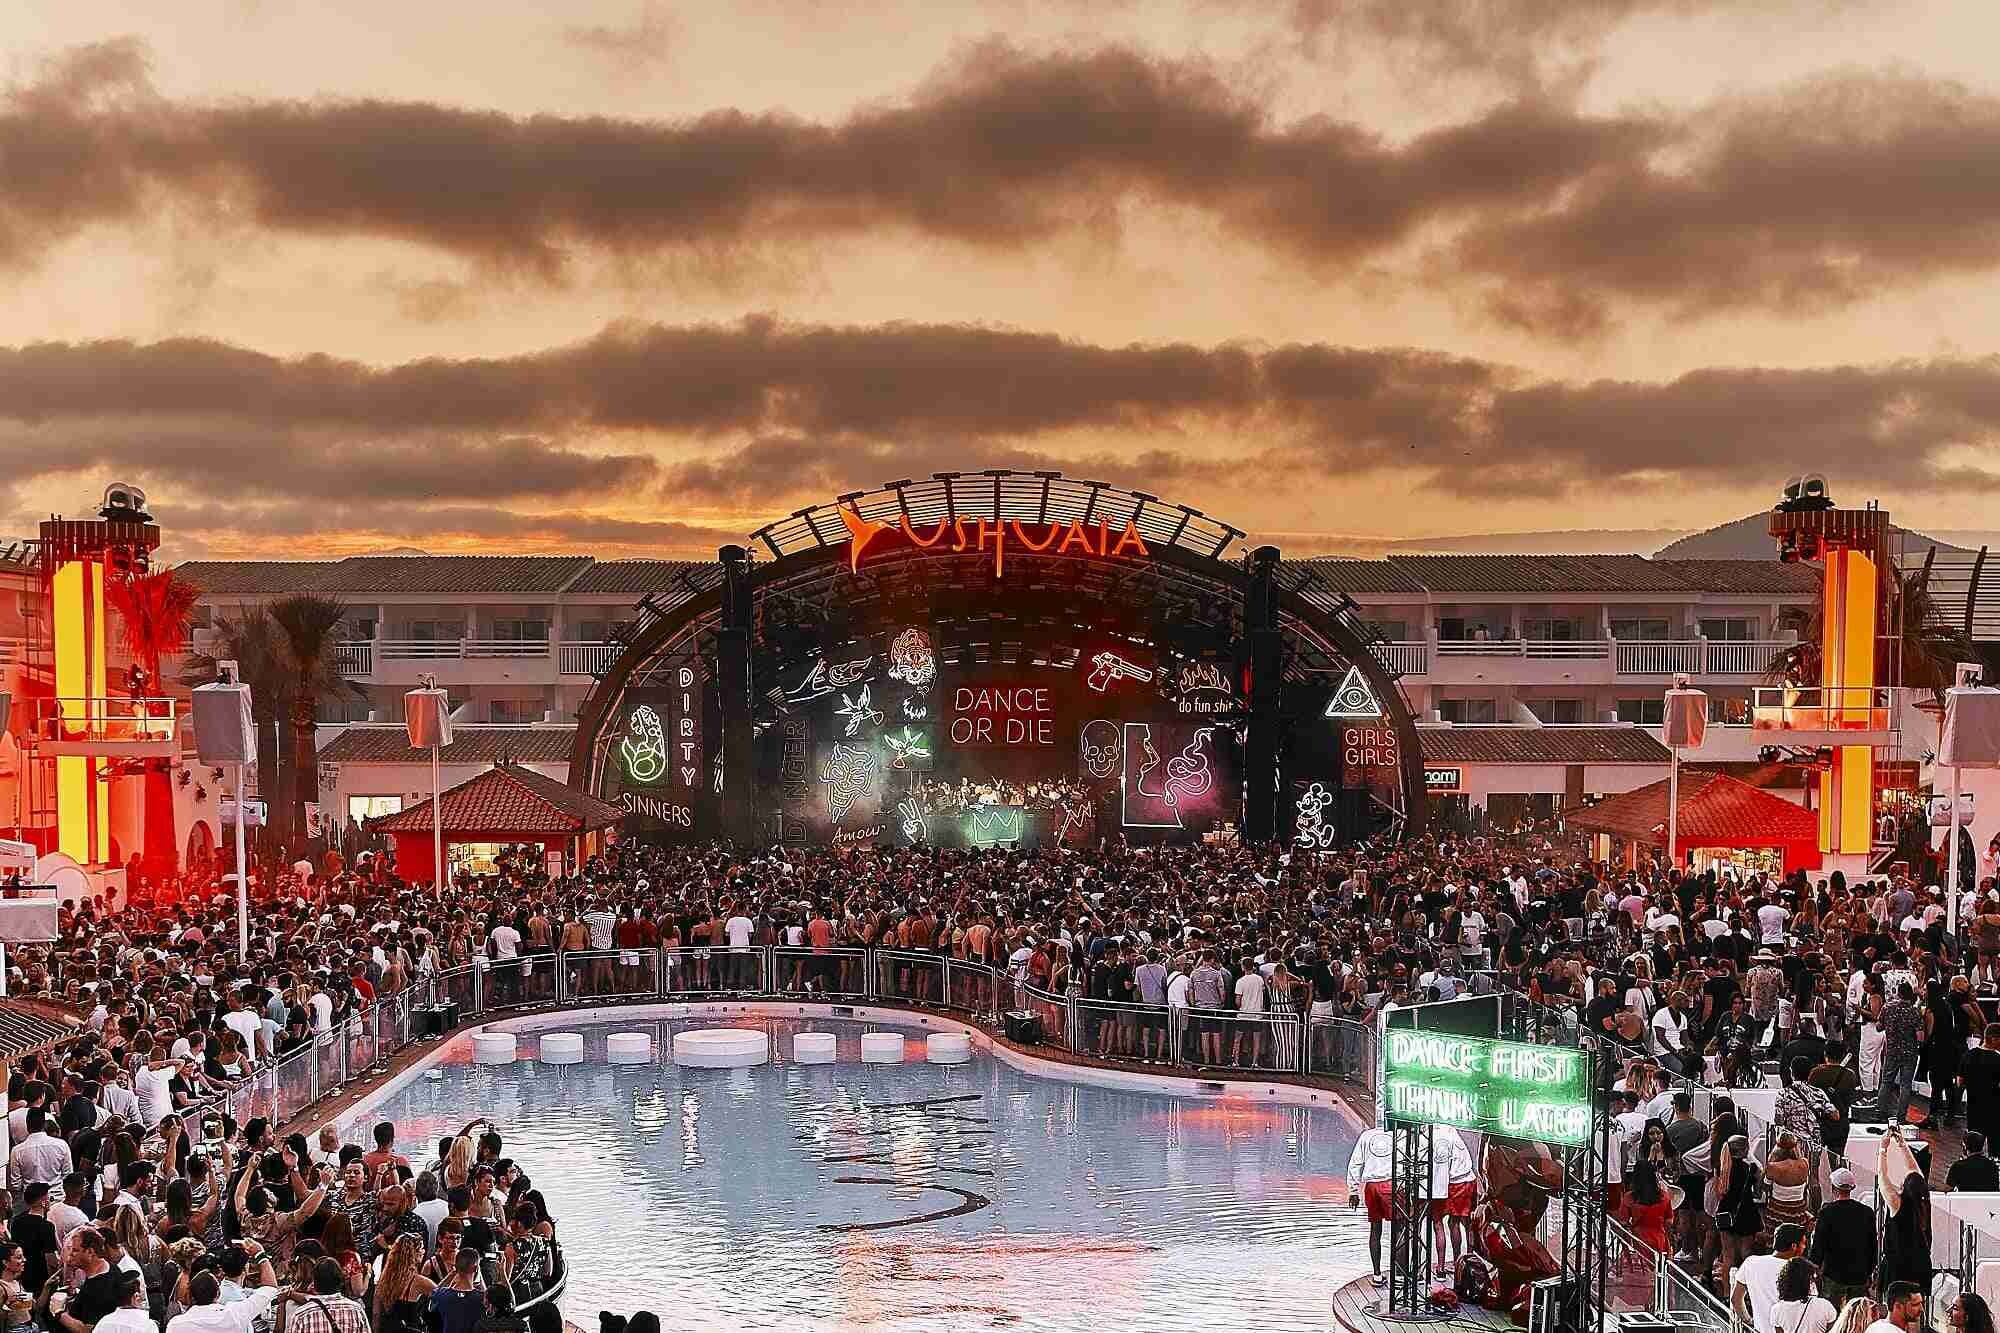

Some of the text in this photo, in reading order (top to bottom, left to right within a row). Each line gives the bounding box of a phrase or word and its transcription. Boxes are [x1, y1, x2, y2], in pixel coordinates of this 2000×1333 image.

[955, 687, 1050, 712] DANCE
[1179, 696, 1234, 713] do fun shit
[679, 667, 696, 786] DIRTY
[951, 717, 1054, 744] OR DIE
[1345, 728, 1396, 747] GIRLS
[1345, 747, 1396, 766] GIRLS
[622, 792, 691, 827] SINNERS
[1392, 1034, 1570, 1082] DANCE FIRST
[1393, 1081, 1590, 1139] THINK LATER
